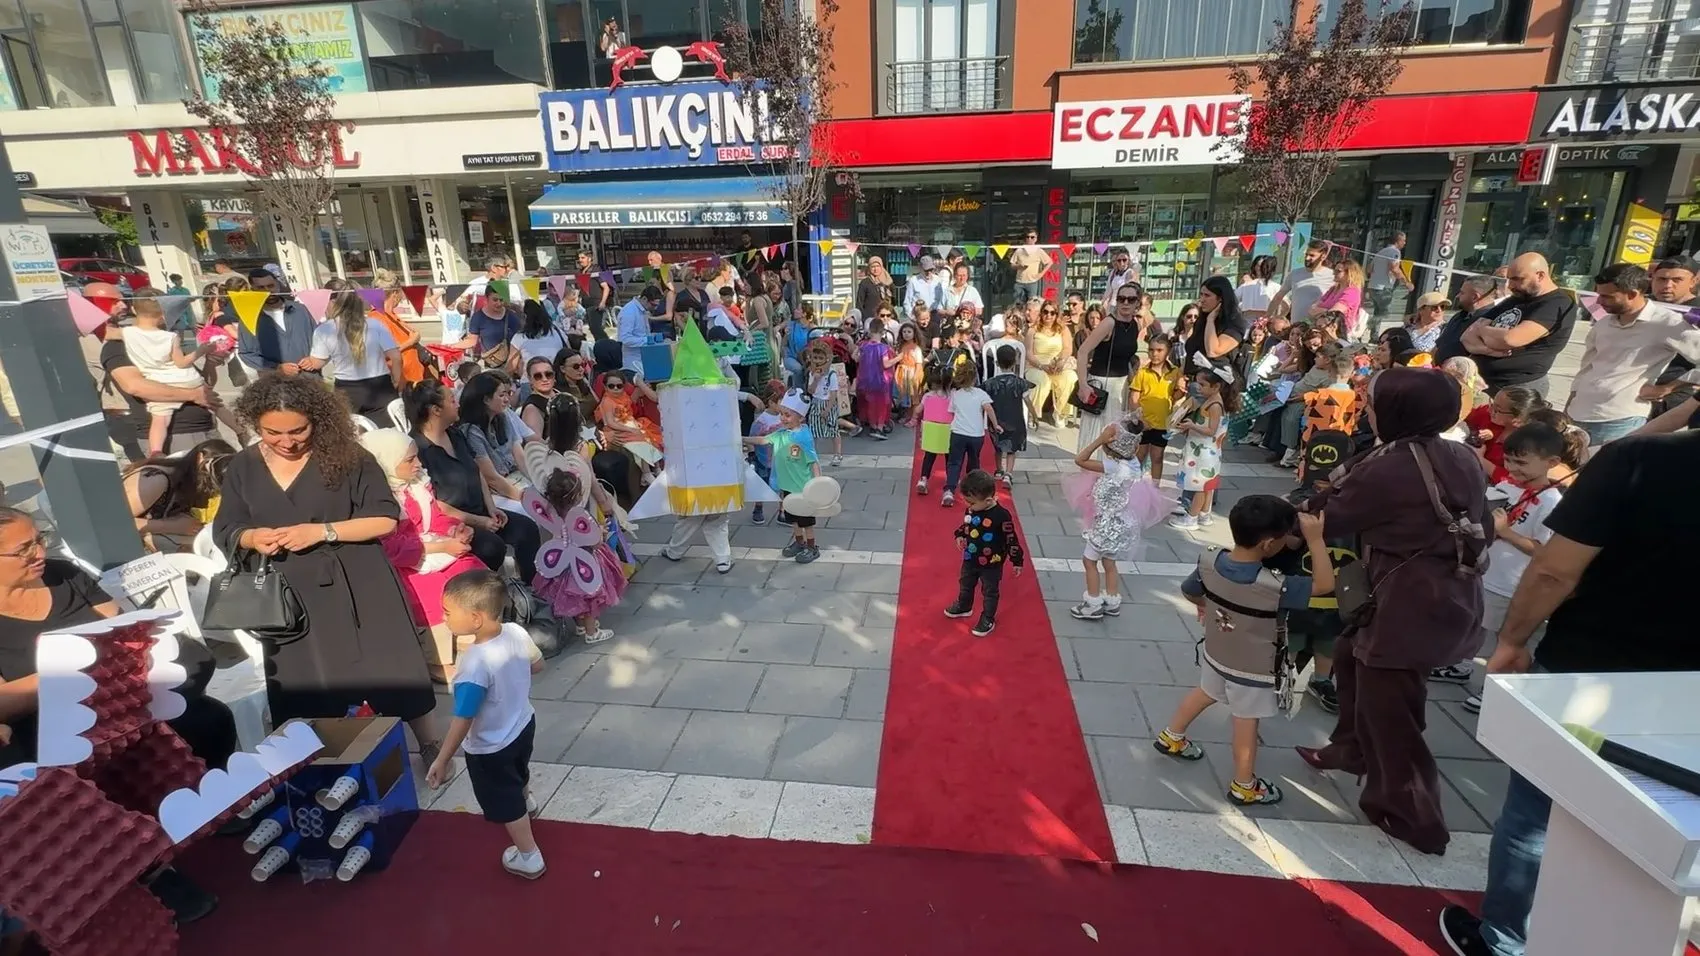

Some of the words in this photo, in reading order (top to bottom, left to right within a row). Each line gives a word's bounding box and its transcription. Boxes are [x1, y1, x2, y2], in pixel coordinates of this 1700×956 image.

[547, 90, 801, 160] BALIKÇINI
[1060, 102, 1241, 143] ECZANE
[467, 156, 482, 165] AYNI
[483, 156, 494, 164] TAT
[495, 155, 518, 163] UYGUN
[518, 154, 536, 163] FİYAT
[719, 147, 754, 160] ERDAL
[1115, 144, 1179, 164] DEMİR
[1559, 149, 1610, 161] OPTİK
[552, 210, 621, 225] PARSELLER
[756, 210, 768, 221] 36
